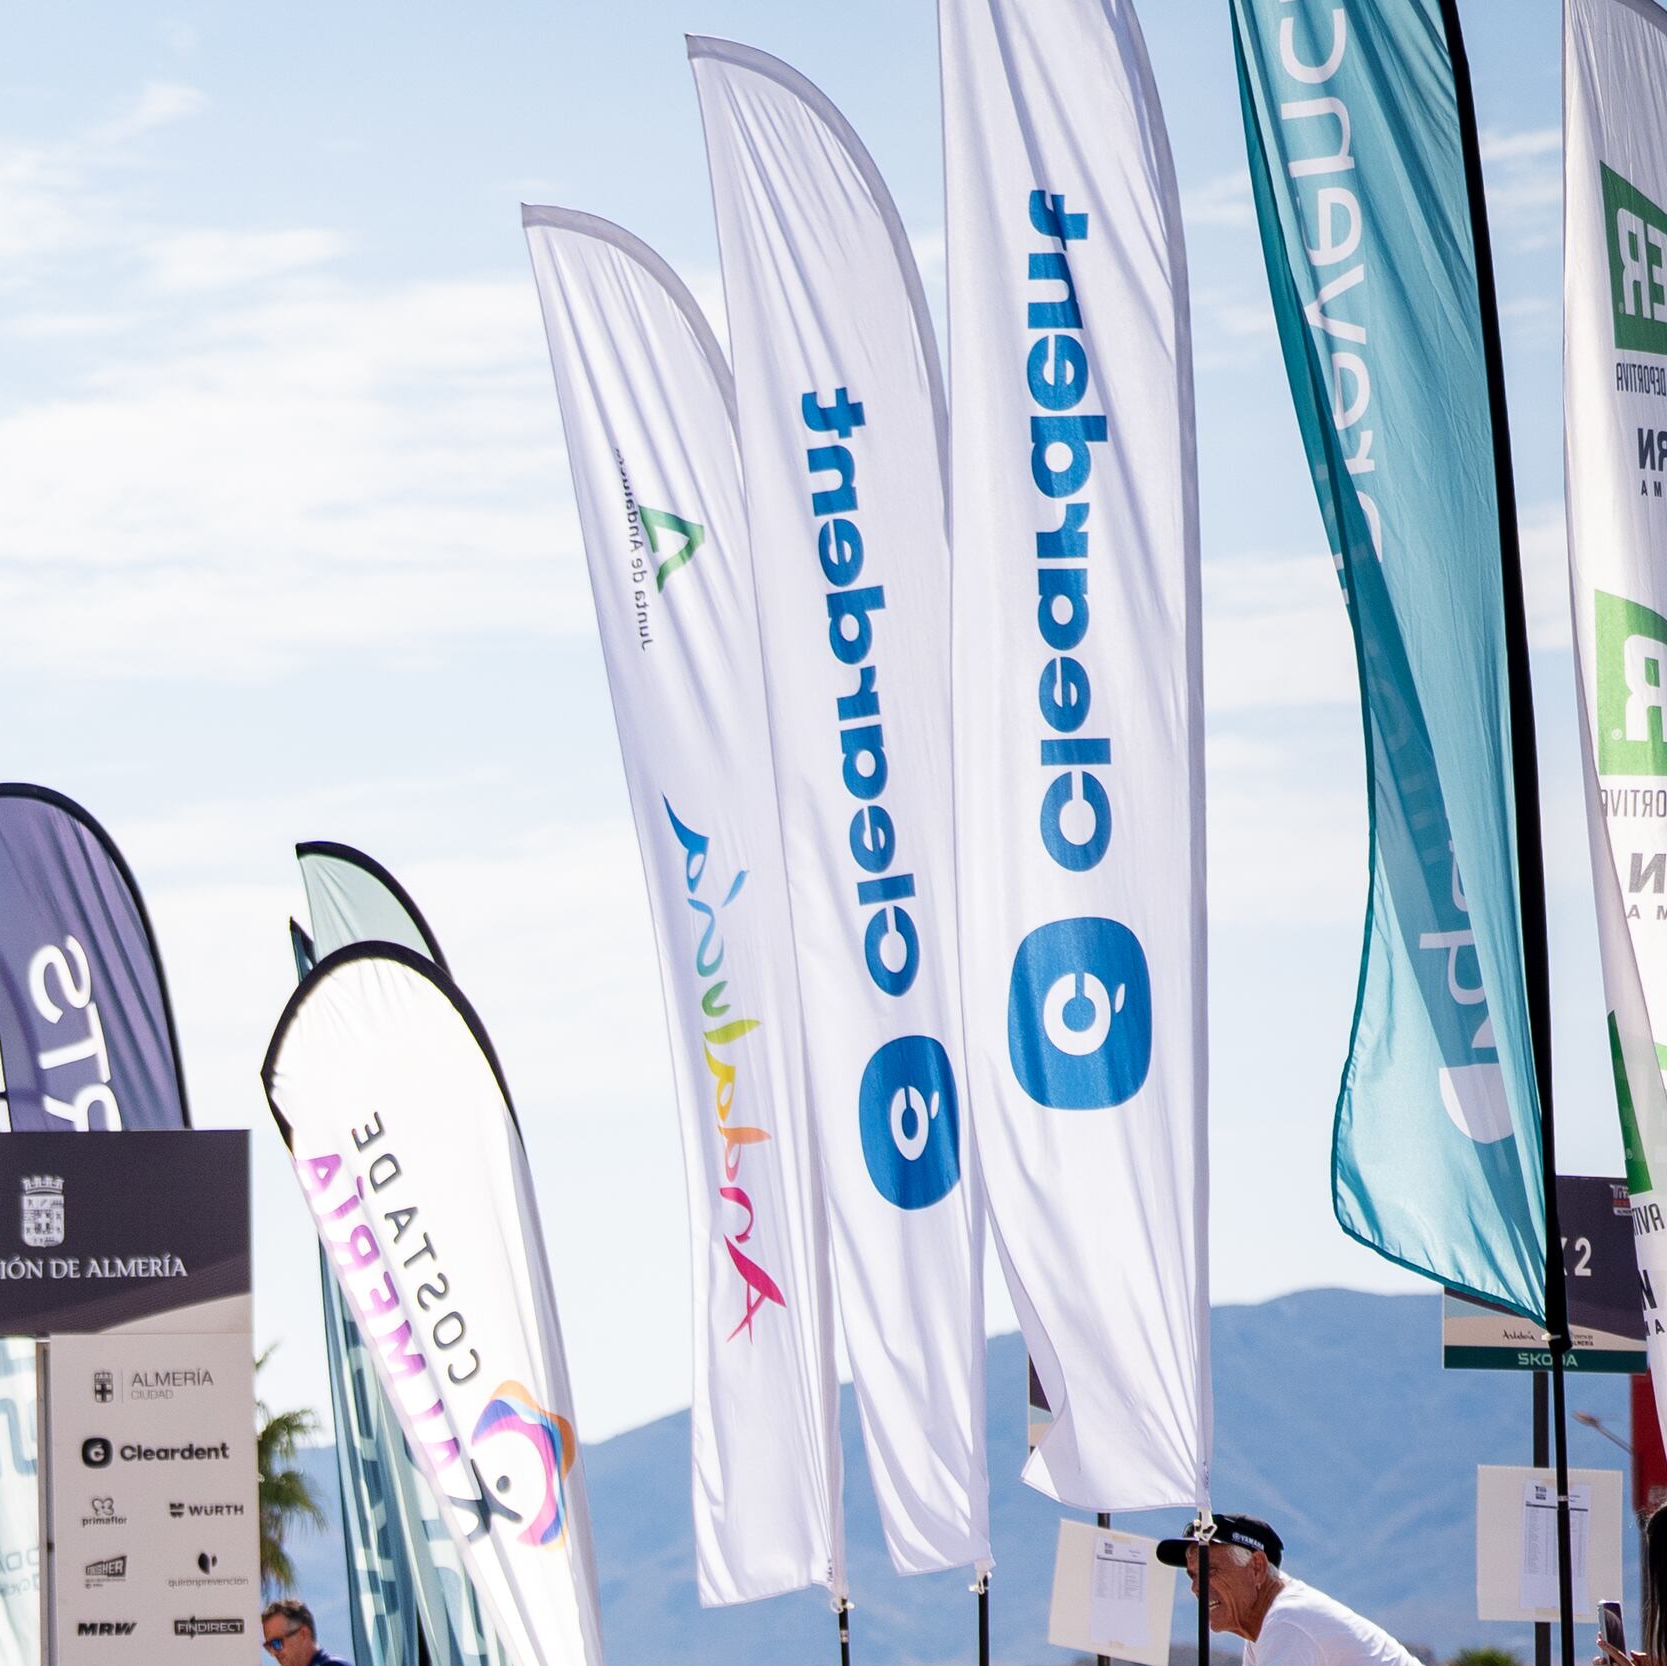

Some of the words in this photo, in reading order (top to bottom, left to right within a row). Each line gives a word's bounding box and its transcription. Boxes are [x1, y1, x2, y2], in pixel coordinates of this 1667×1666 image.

[1574, 1237, 1593, 1277] 2
[50, 1257, 82, 1280] DE
[84, 1252, 189, 1279] ALMERÍA
[131, 1368, 214, 1388] ALMERÍA
[131, 1389, 174, 1400] CIUDAD
[119, 1442, 230, 1462] Cleardent
[82, 1515, 127, 1527] primaflor
[77, 1622, 138, 1637] MRW
[177, 1622, 244, 1633] FINDIRECT
